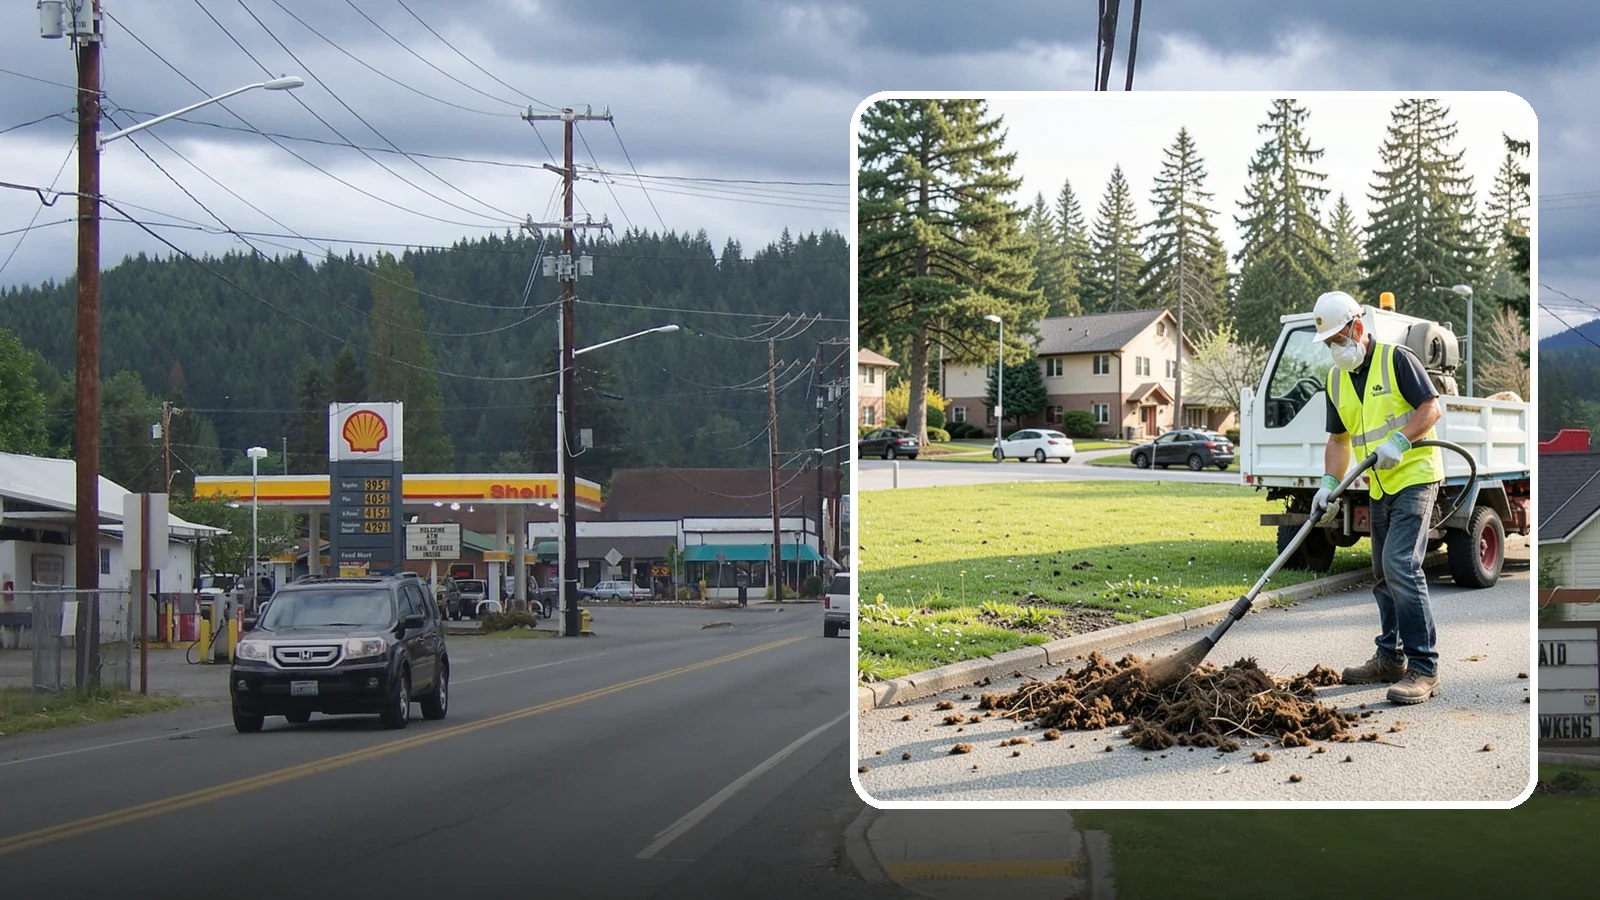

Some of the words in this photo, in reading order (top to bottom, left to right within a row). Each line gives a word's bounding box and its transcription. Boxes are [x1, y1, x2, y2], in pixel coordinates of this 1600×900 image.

[366, 480, 383, 490] 395
[490, 484, 548, 499] Shell
[366, 494, 383, 504] 405
[366, 508, 383, 518] 415
[366, 522, 383, 532] 429
